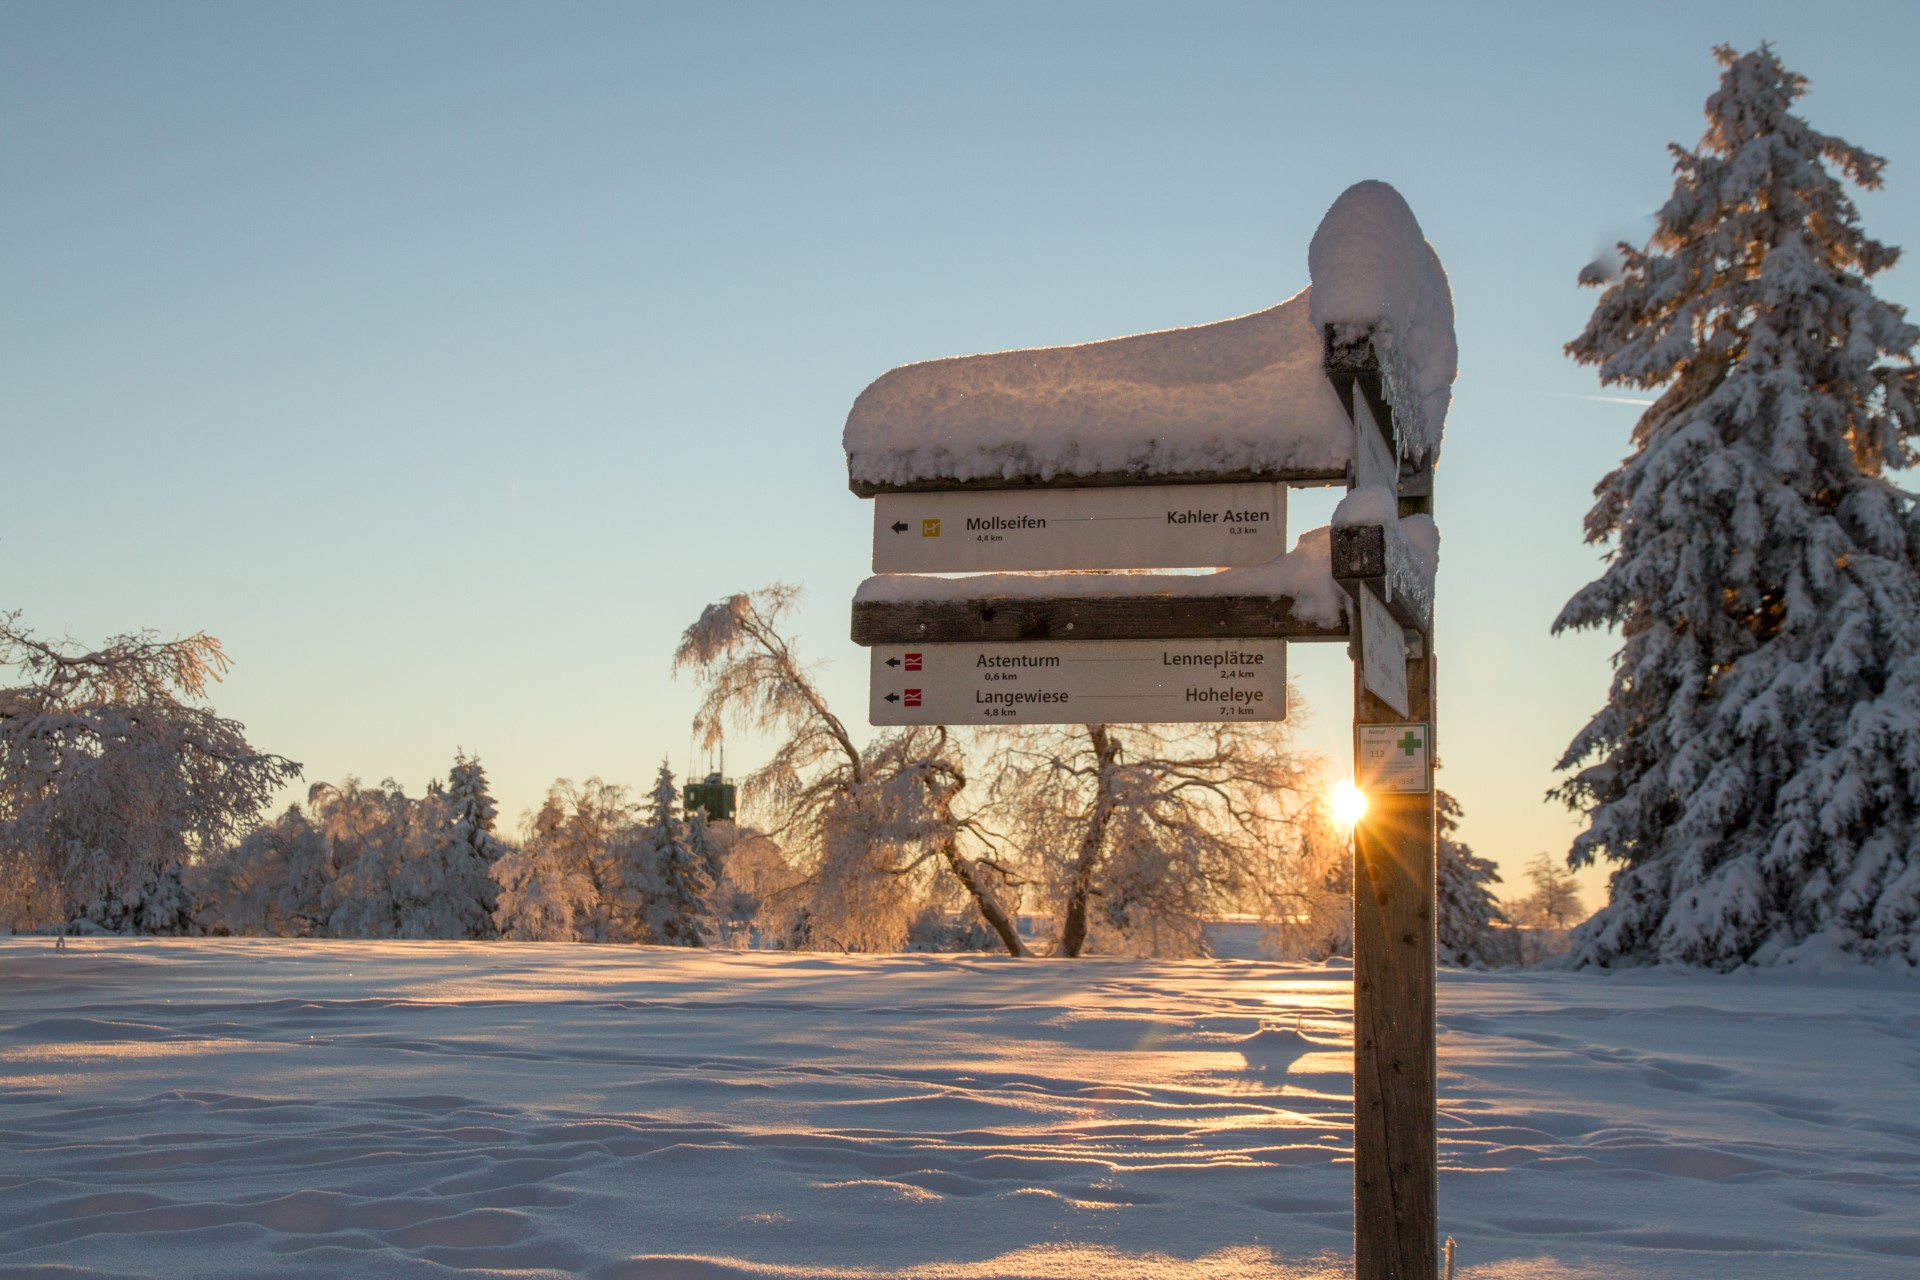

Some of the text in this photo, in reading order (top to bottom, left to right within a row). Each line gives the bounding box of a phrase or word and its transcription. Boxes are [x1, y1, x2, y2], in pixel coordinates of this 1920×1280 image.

[1167, 509, 1270, 524] Kahler Asten
[966, 515, 1046, 531] Mollseifen
[1229, 526, 1258, 536] 0,3 km
[976, 534, 1003, 543] 4,4 km
[976, 653, 1060, 668] Astenturm
[1163, 650, 1264, 669] Lenneplätze
[984, 672, 1018, 682] 0,6 km
[1220, 669, 1255, 680] 2,4 km
[976, 689, 1069, 707] Langewiese
[1186, 687, 1264, 706] Hoheleye
[983, 707, 1017, 718] 4,8 km
[1219, 705, 1255, 717] 7,1 km
[1370, 750, 1385, 758] 112
